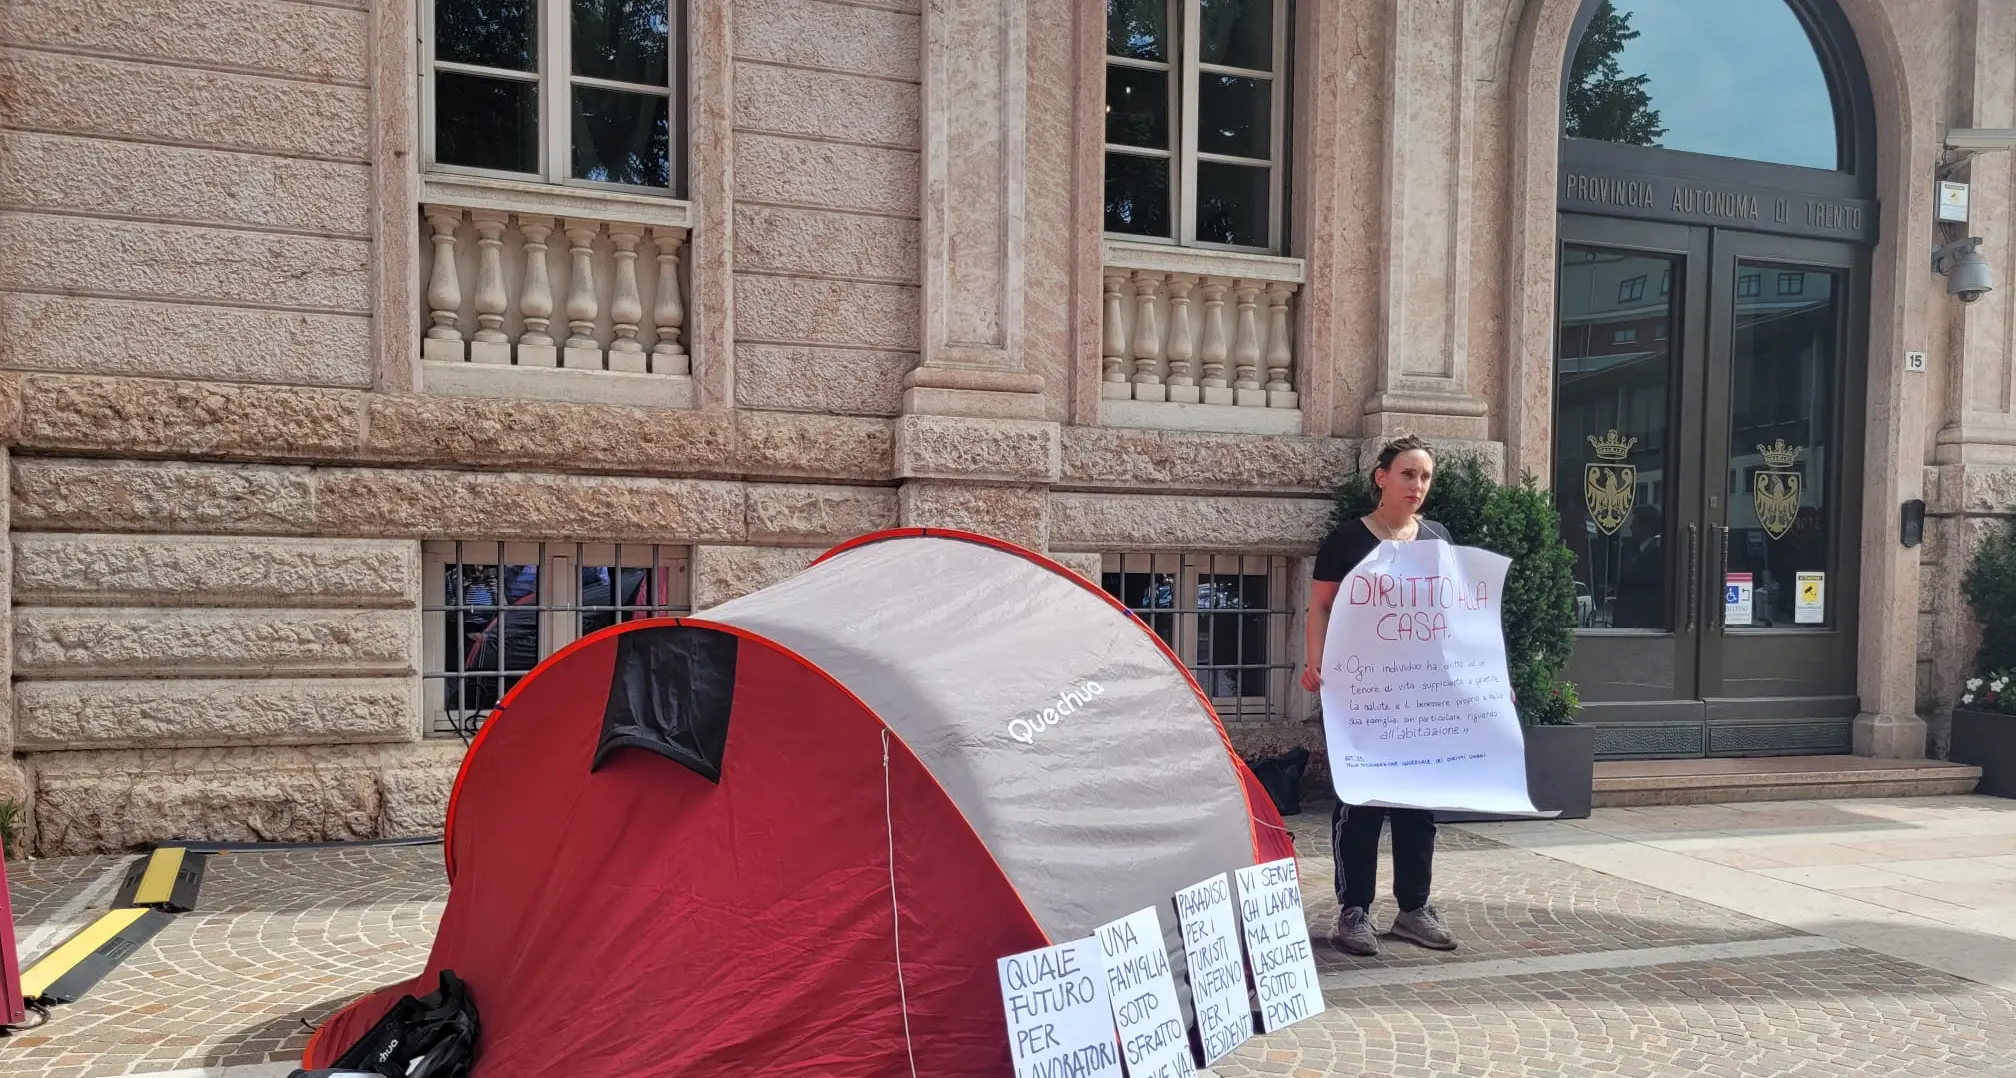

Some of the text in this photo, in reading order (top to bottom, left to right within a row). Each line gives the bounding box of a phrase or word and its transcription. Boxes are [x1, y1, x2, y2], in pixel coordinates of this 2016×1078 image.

[1566, 174, 1862, 231] PROVINCIA AUTONOMA DI TRENTO
[1909, 354, 1923, 368] 15
[1382, 659, 1422, 673] individuo
[1426, 660, 1438, 671] ha
[1350, 683, 1380, 696] tenore
[1384, 684, 1393, 692] di
[1399, 681, 1415, 691] vita
[1363, 701, 1391, 711] salute
[1007, 681, 1105, 744] Quechua
[1419, 713, 1460, 724] particolare
[1467, 711, 1498, 723] riguardo
[1239, 862, 1297, 894] VI SERVE
[1178, 880, 1228, 920] PARADISO
[1264, 886, 1301, 916] LAVORA
[1100, 921, 1138, 957] UNA
[1186, 917, 1215, 946] PER I
[1248, 920, 1290, 949] MA LO
[1006, 948, 1081, 991] QUALE
[1106, 949, 1168, 997] FAMIGLIA
[1188, 936, 1229, 979] TURISTI
[1252, 940, 1308, 975] LASCIATE
[1009, 976, 1095, 1024] FUTURO
[1194, 960, 1241, 1004] INFERNO
[1260, 968, 1309, 1002] SOTTO I
[1119, 991, 1159, 1027] SOTTO
[1200, 996, 1230, 1036] PER I
[1266, 993, 1309, 1030] PONTI
[1017, 1024, 1060, 1058] PER
[1127, 1018, 1182, 1065] SFRATTO
